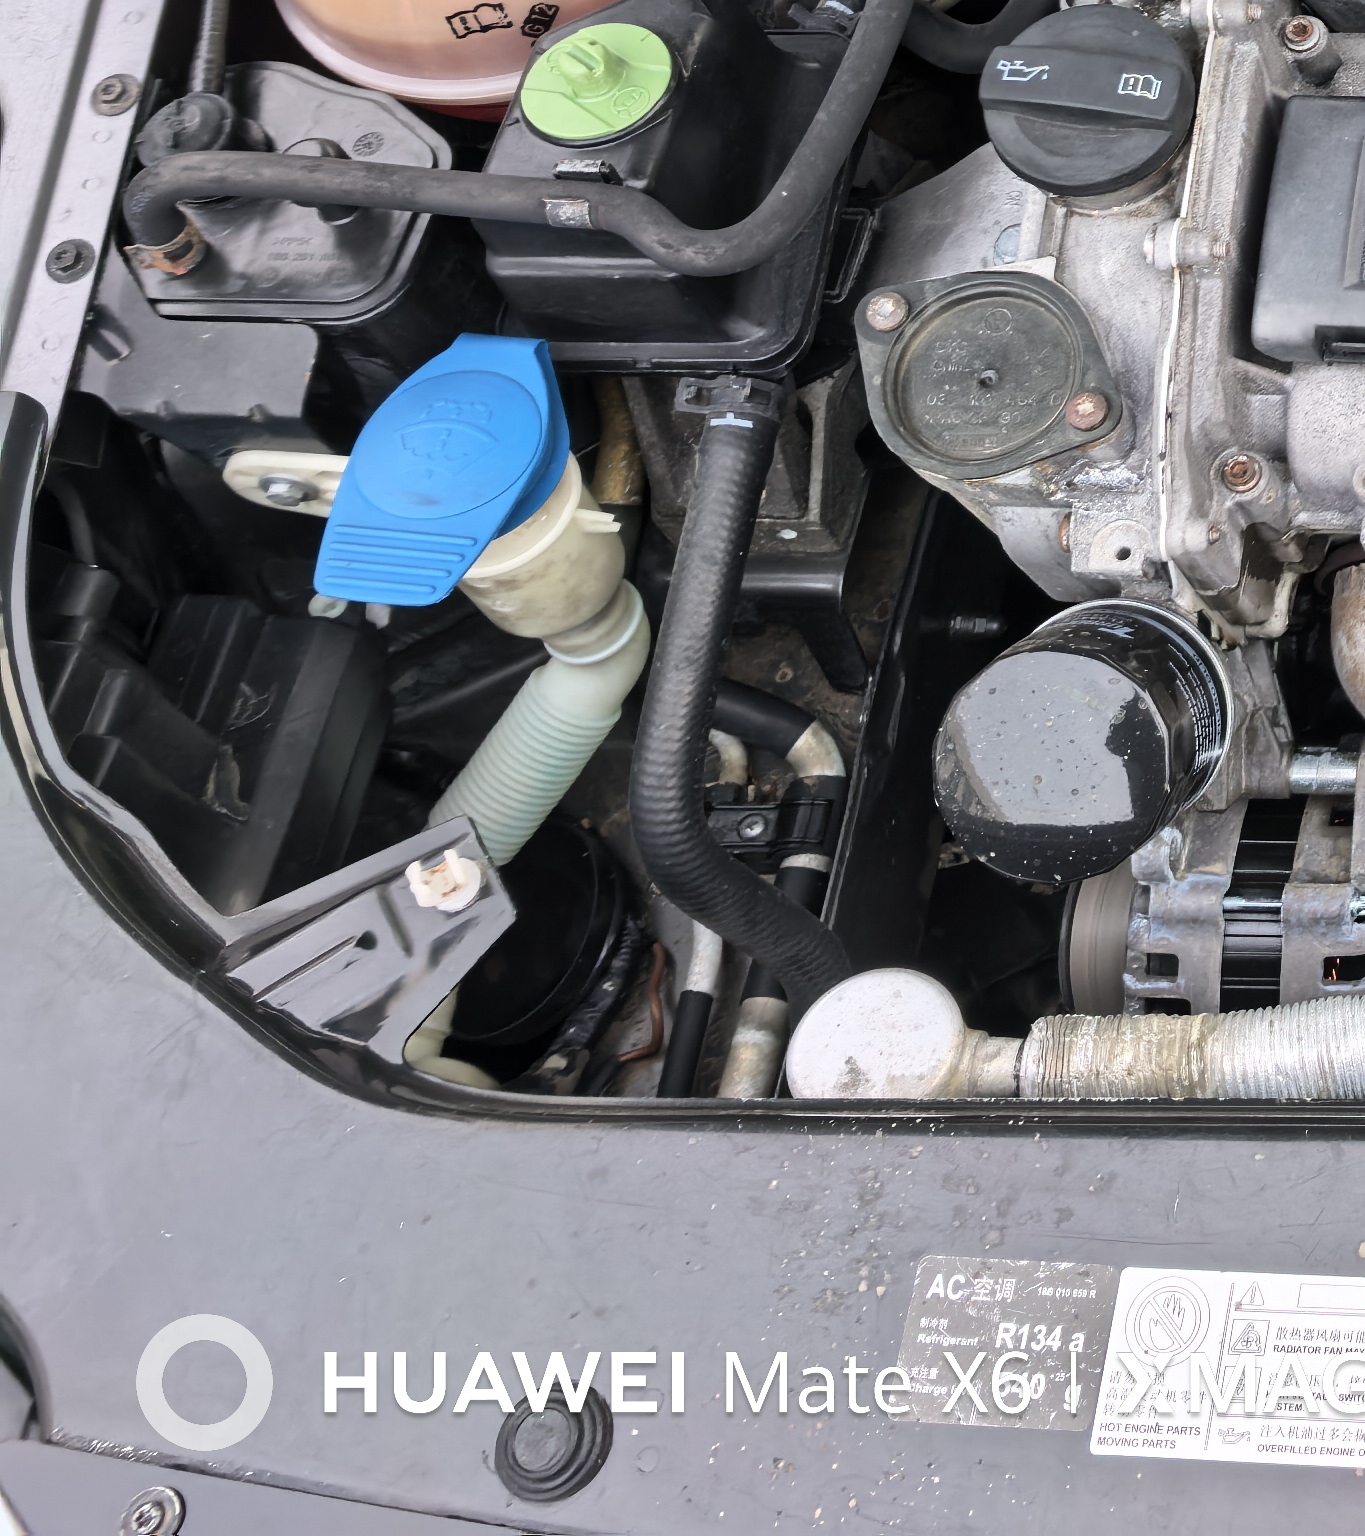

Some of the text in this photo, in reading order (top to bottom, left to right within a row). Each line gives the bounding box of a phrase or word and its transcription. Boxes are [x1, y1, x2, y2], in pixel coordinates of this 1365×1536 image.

[526, 4, 556, 35] G12
[926, 1273, 966, 1300] AC
[971, 1278, 1016, 1302] 空调
[1273, 1344, 1321, 1355] RADIATOR
[1324, 1346, 1342, 1355] FAN
[1100, 1422, 1201, 1436] HOT ENGINE PARTS
[1096, 1436, 1176, 1449] MOVING PARTS
[1257, 1444, 1317, 1455] OVERFILLED
[1319, 1446, 1356, 1457] ENGINE
